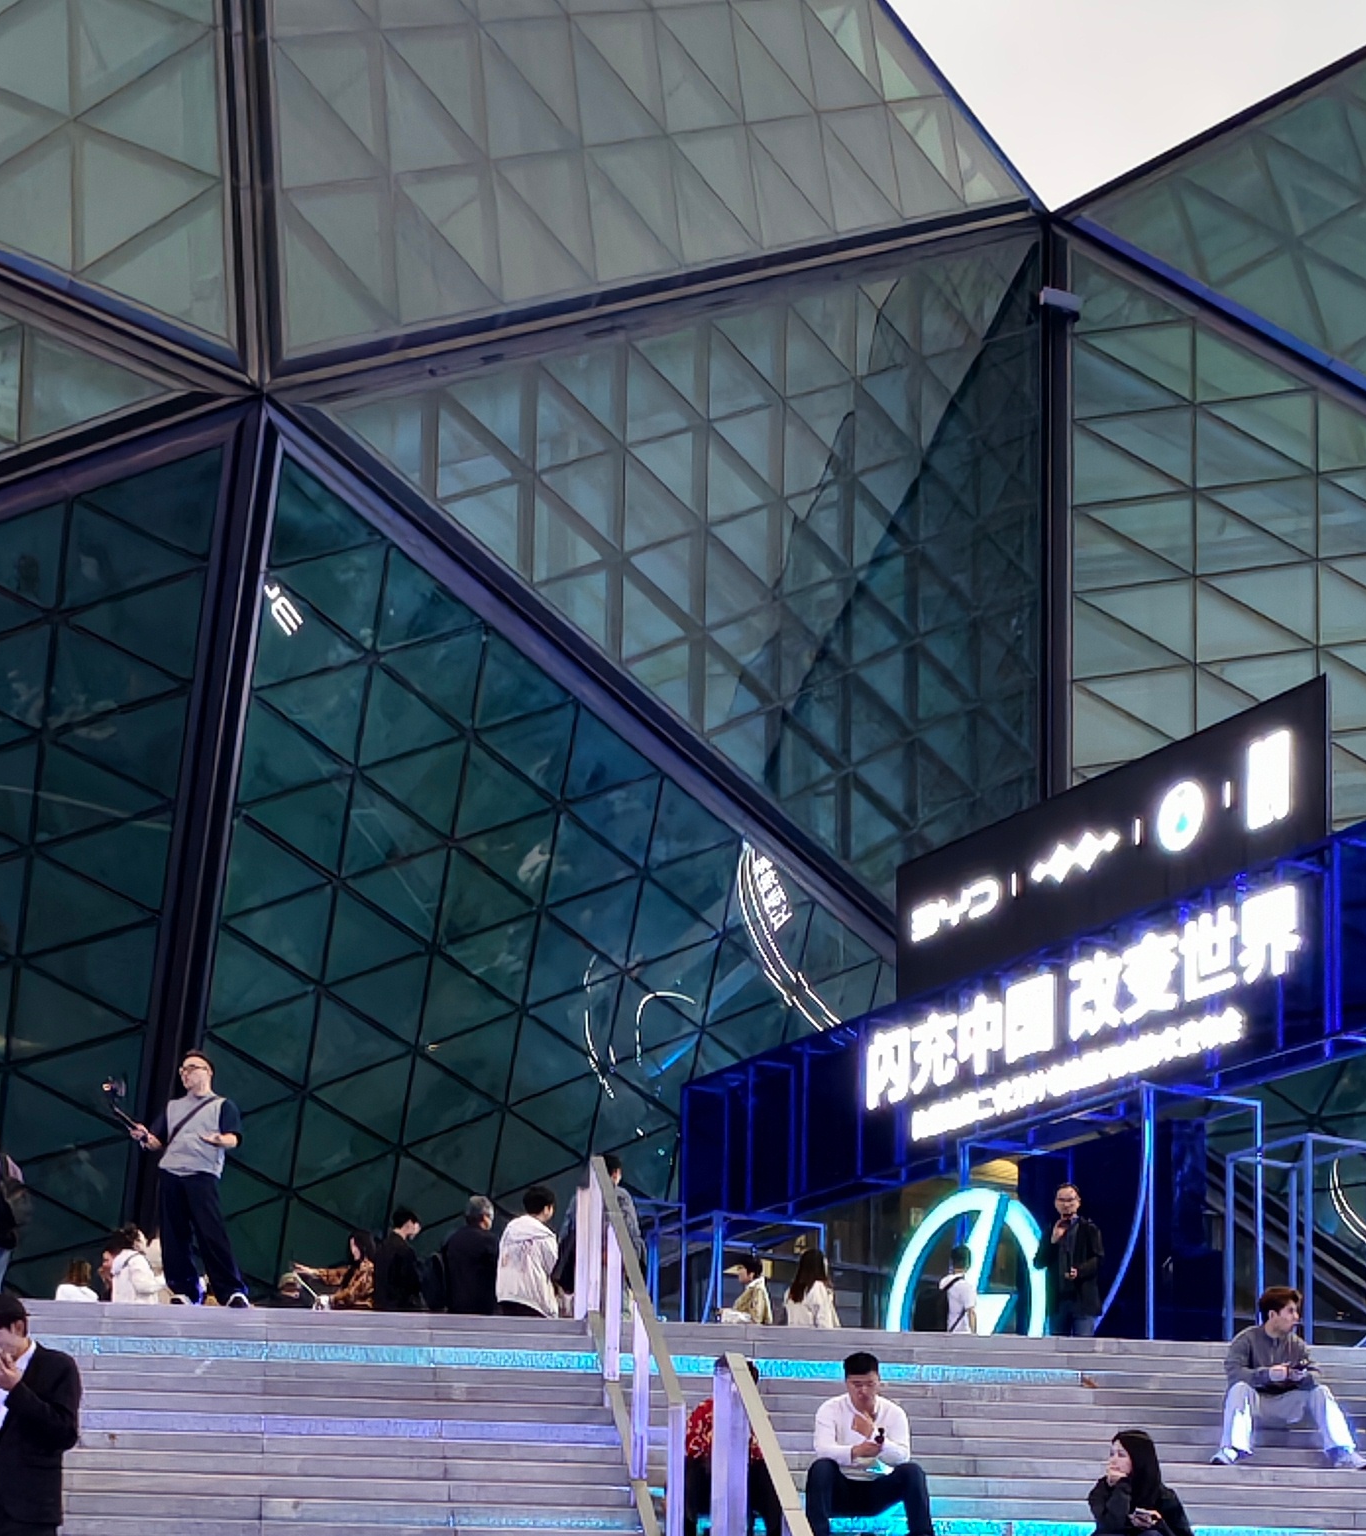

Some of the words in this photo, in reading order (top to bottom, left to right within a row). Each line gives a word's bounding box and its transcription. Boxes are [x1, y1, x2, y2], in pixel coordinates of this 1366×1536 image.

[865, 972, 1057, 1111] 闪充中国
[1068, 884, 1302, 1042] 改变世界
